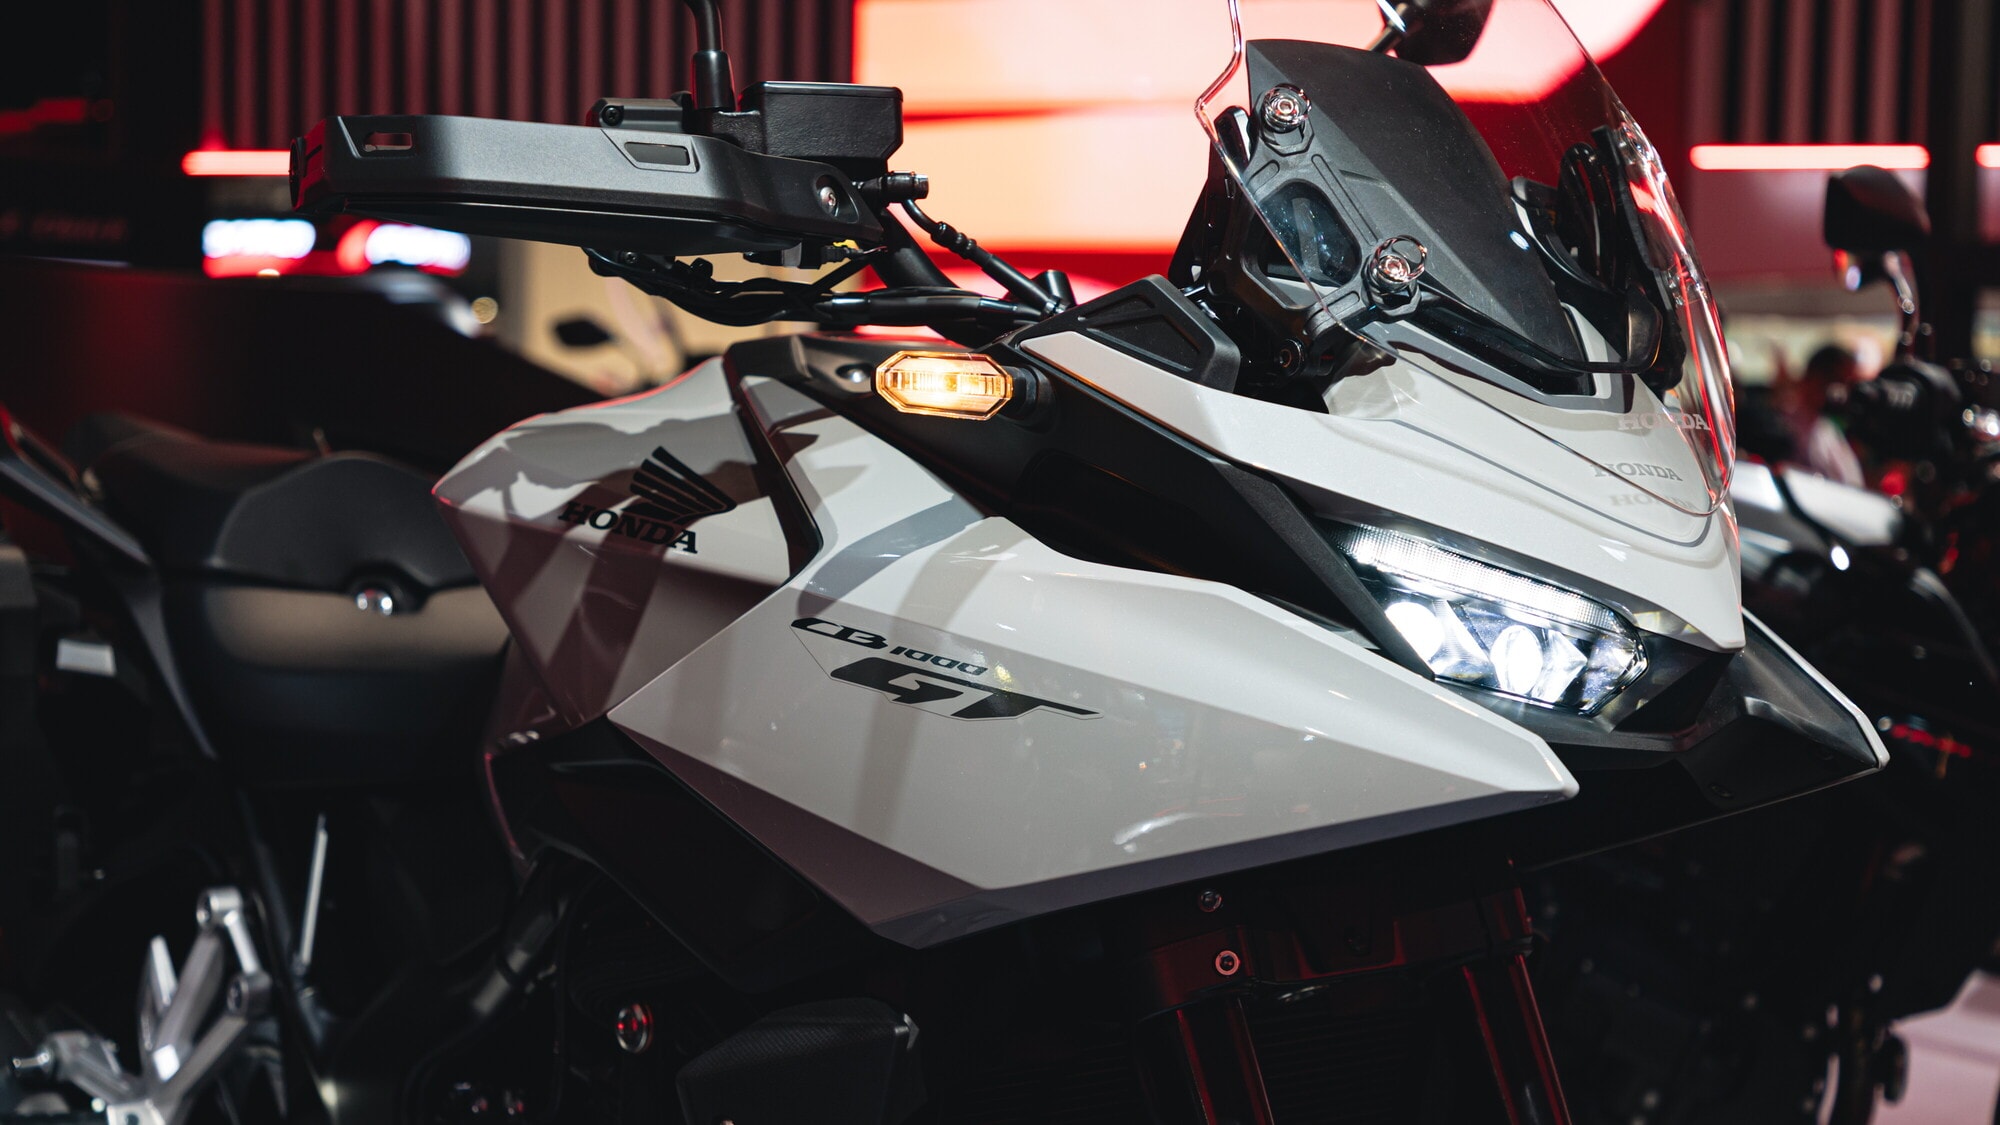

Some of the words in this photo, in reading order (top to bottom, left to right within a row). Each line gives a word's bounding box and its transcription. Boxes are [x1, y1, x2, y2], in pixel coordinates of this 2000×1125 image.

[1590, 462, 1684, 483] HONDA
[558, 501, 698, 554] HONDA
[830, 656, 1101, 719] GT
